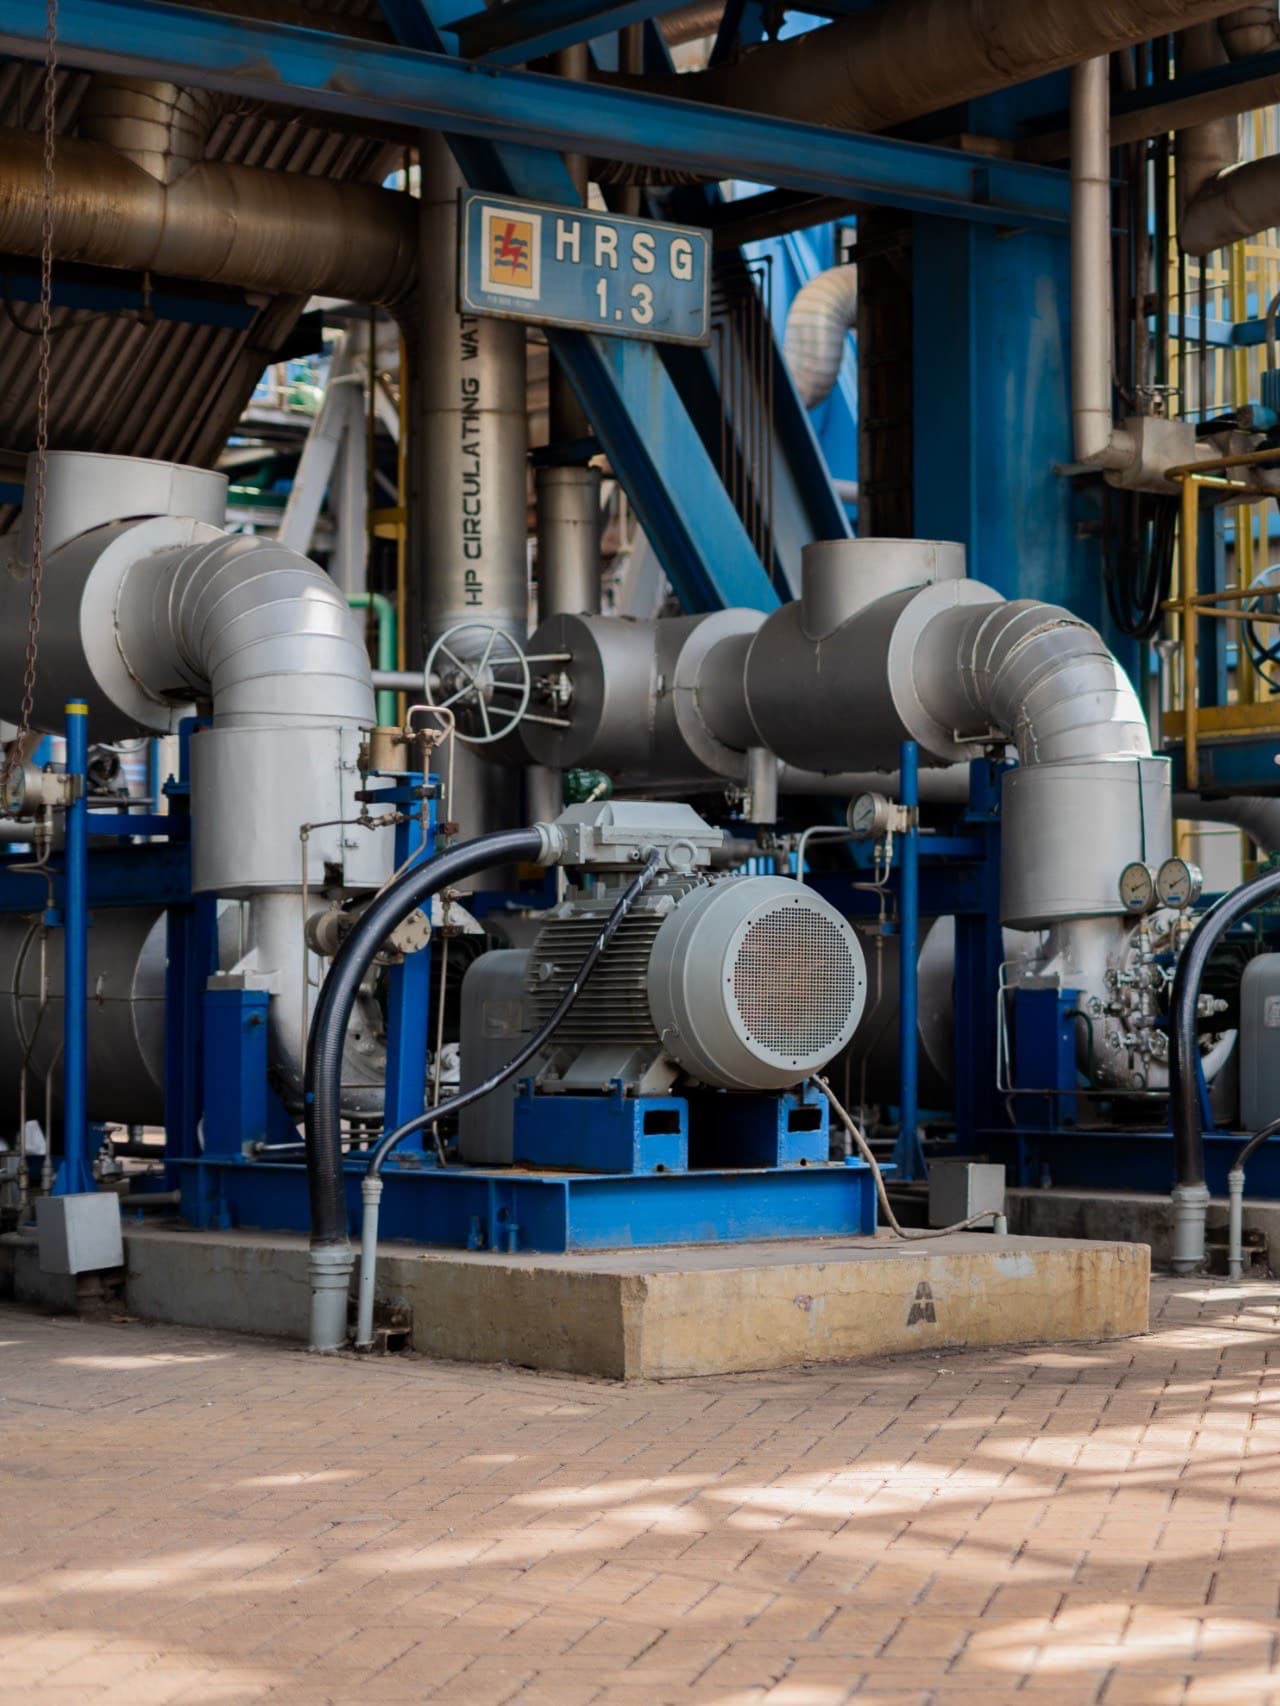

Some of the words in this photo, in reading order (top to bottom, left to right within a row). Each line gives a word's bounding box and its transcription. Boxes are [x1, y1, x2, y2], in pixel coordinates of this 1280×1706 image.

[596, 278, 654, 324] 1.3
[461, 377, 482, 560] CIRCULATING
[464, 569, 483, 606] HP
[906, 1281, 937, 1326] A
